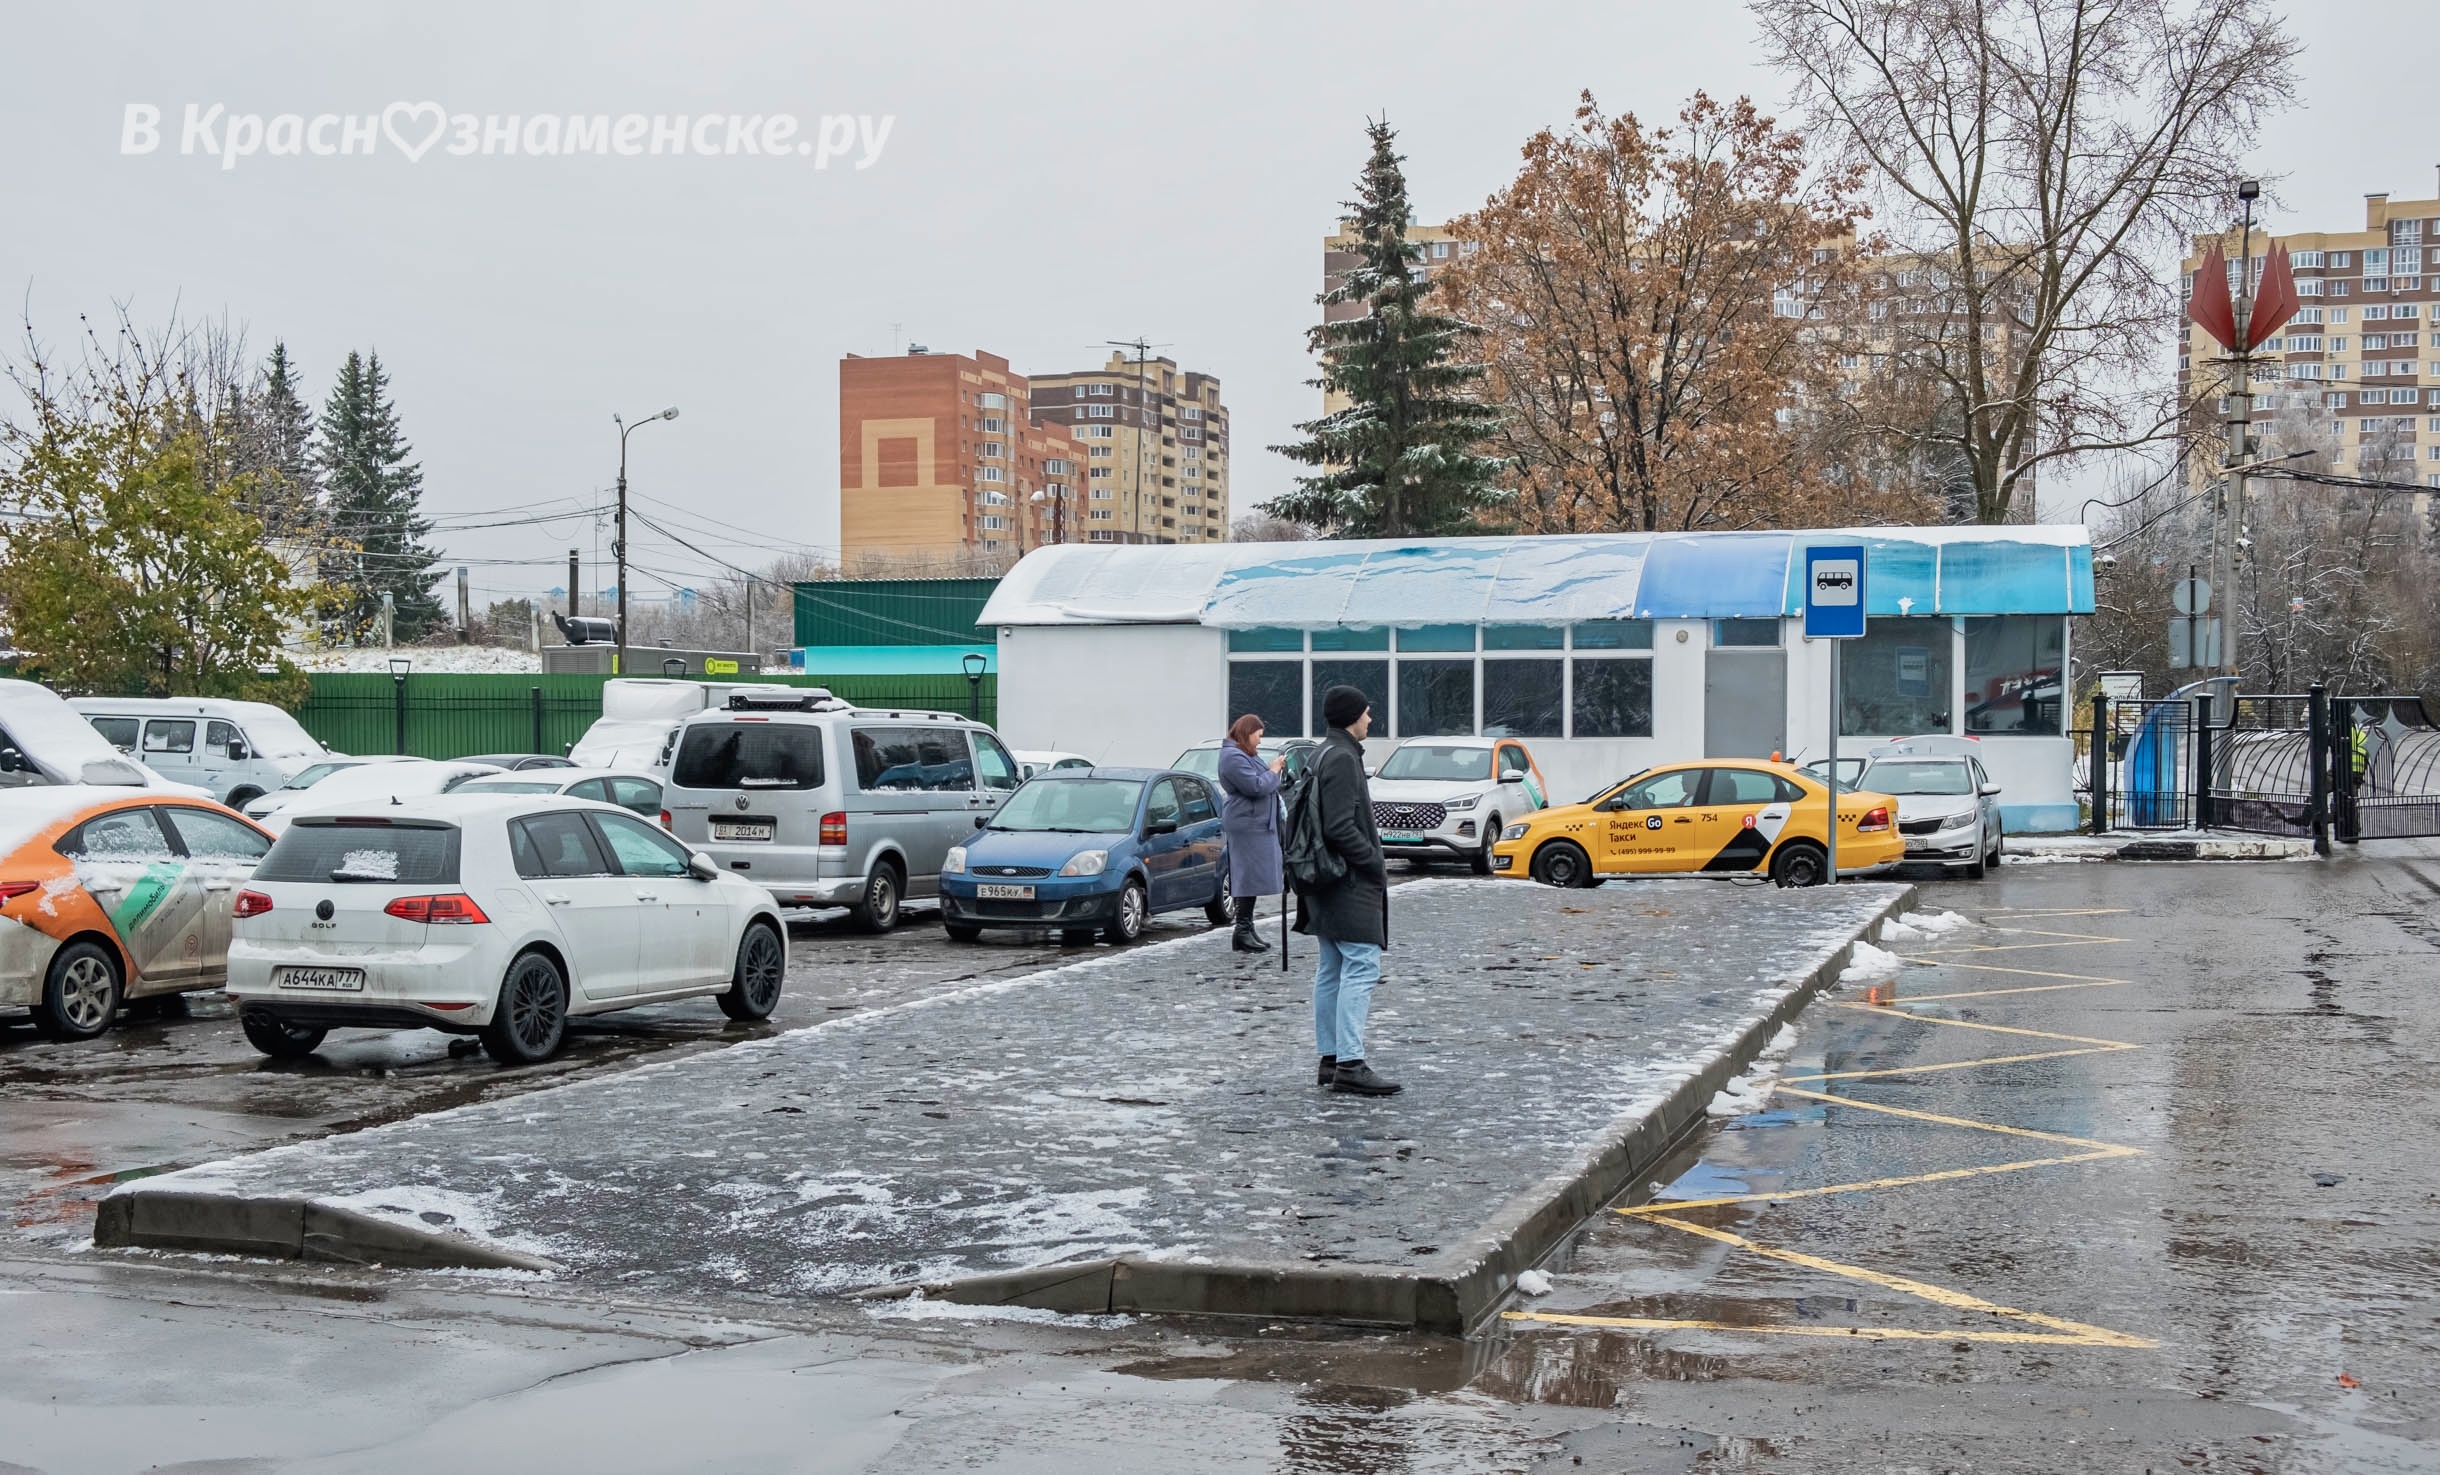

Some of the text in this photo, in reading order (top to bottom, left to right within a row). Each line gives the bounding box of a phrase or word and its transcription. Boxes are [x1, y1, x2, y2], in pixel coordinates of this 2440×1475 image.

[1701, 813, 1718, 822] 754
[1609, 820, 1644, 830] Яндекс
[1647, 818, 1661, 829] Go
[1609, 833, 1636, 843] Такси
